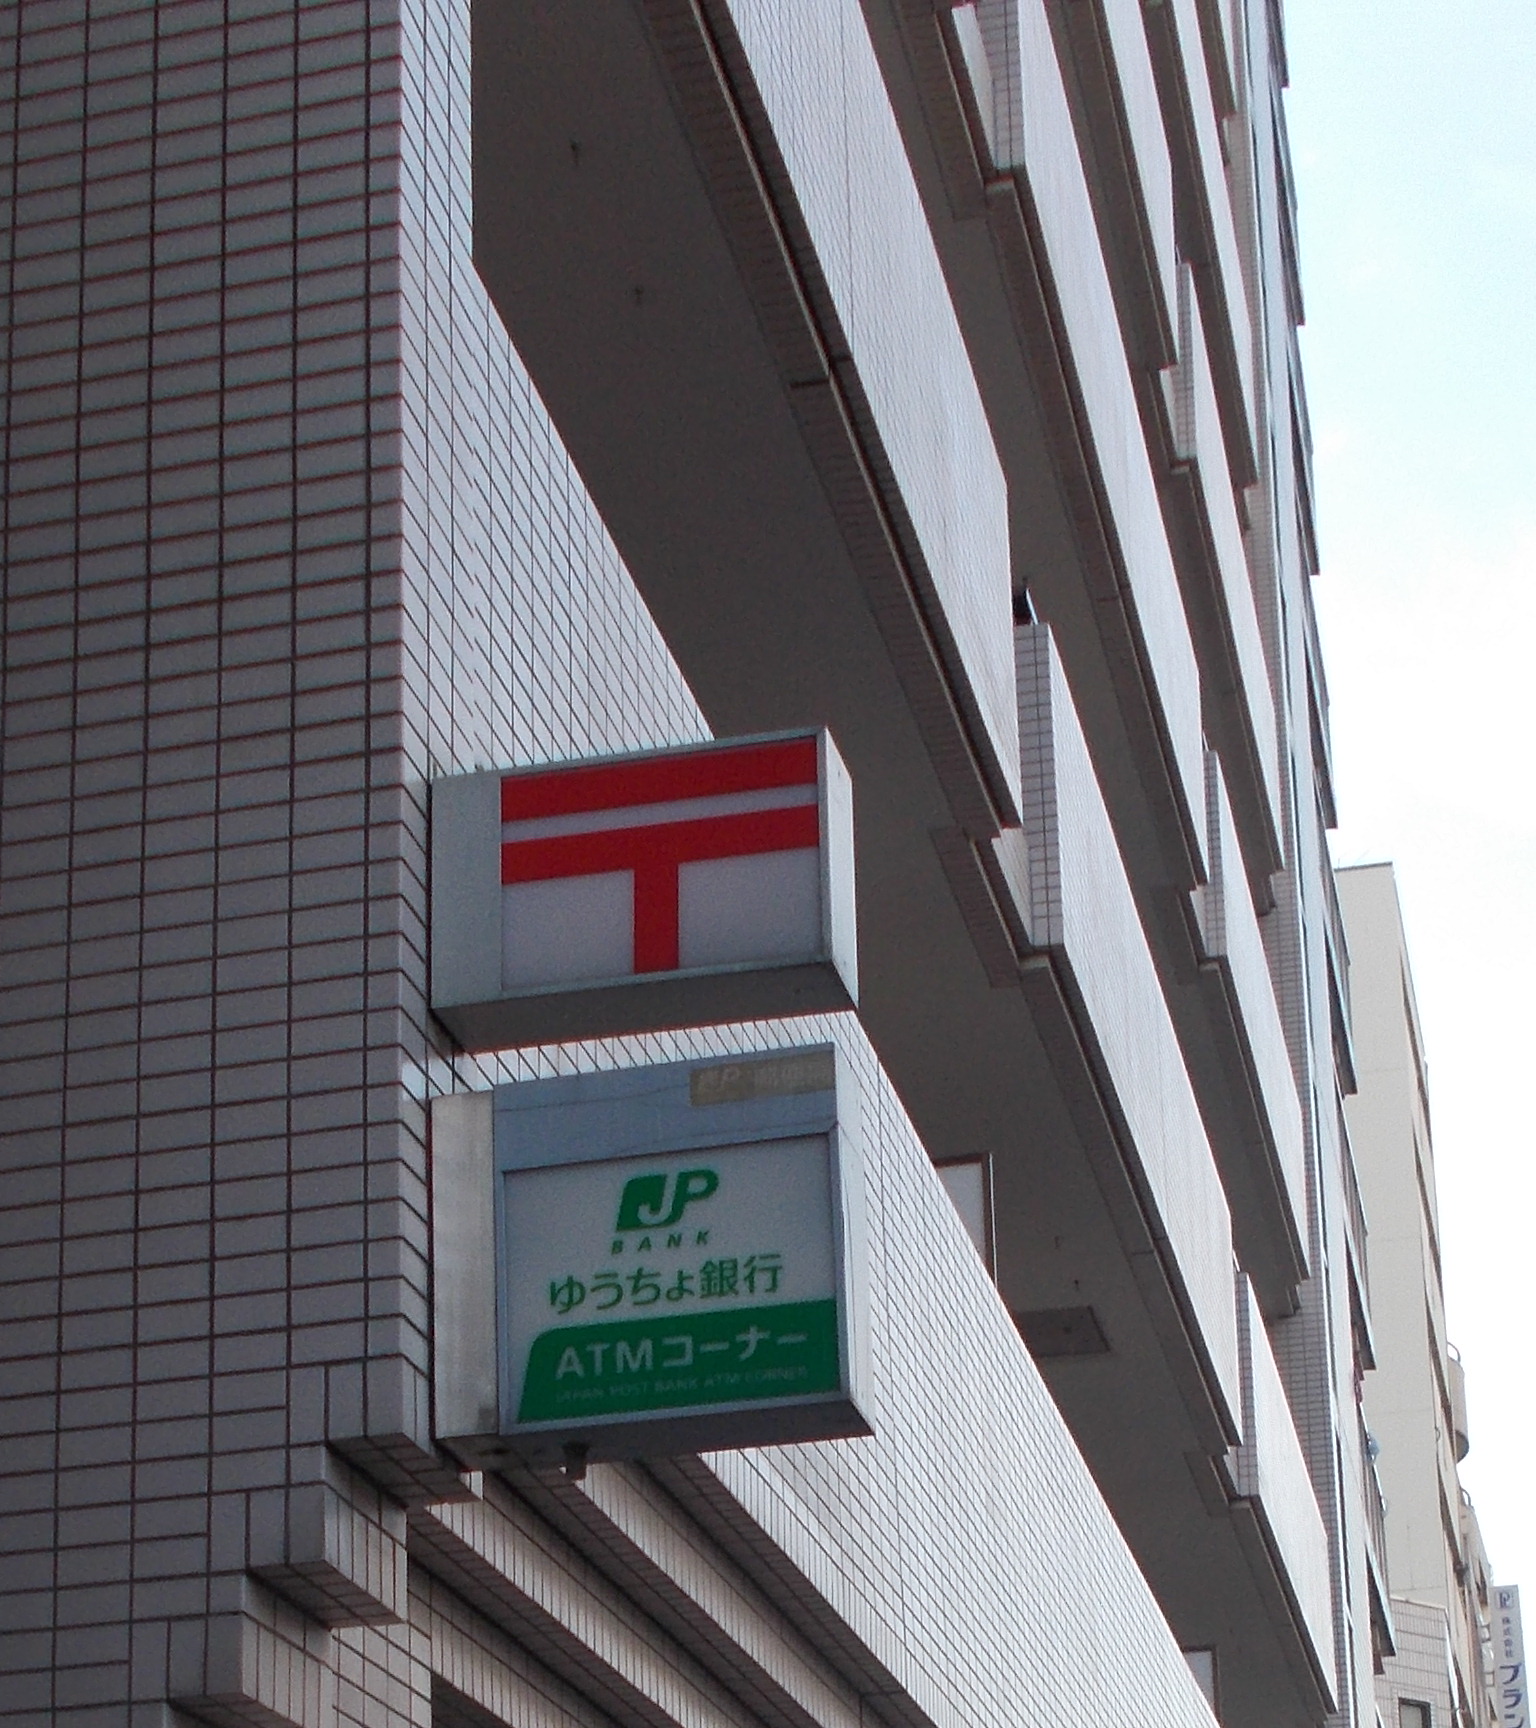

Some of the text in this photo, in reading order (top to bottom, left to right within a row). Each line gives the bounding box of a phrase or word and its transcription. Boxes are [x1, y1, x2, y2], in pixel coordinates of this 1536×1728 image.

[616, 1170, 719, 1231] JP
[611, 1230, 709, 1255] BANK
[550, 1254, 782, 1314] ゆうちょ銀行
[555, 1325, 808, 1380] ATMコーナー
[557, 1366, 808, 1402] JAPAN POST BANK ATM CORNER
